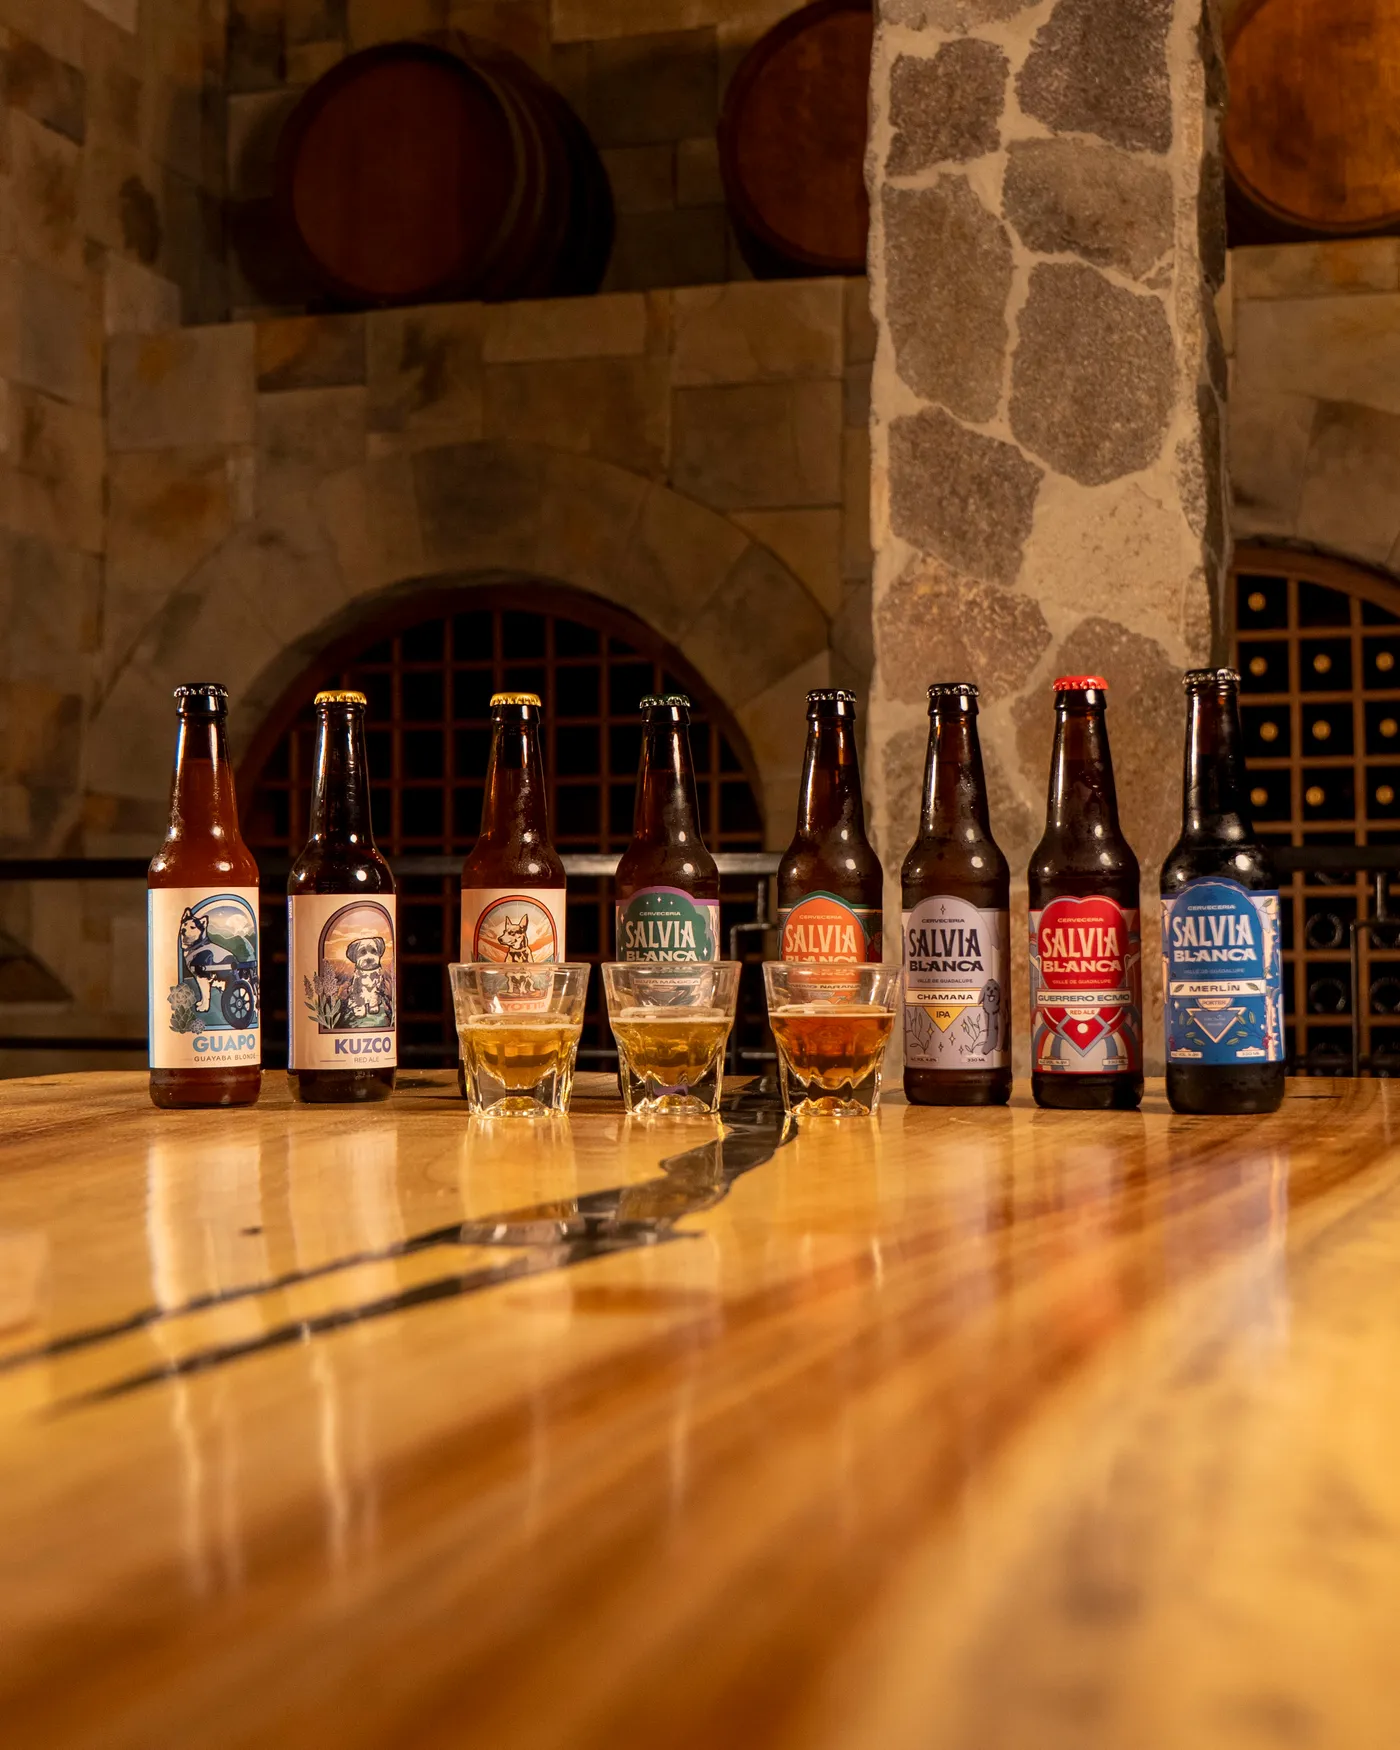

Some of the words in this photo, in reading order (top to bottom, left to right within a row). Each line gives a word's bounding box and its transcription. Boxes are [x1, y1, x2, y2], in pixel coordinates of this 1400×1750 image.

[625, 920, 696, 948] SALVIA
[785, 924, 858, 953] SALVIA
[1172, 914, 1255, 947] SALVIA
[909, 928, 982, 957] SALVIA
[1042, 927, 1120, 958] SALVIA
[626, 950, 699, 962] BLANCA
[1173, 948, 1257, 962] BLANCA
[909, 960, 984, 972] BLANCA
[1043, 959, 1122, 973] BLANCA
[1189, 982, 1241, 992] MERLÍN
[1038, 994, 1095, 1002] GUERRERO
[1097, 993, 1130, 1002] ECMO
[192, 1034, 256, 1053] GUAPO
[334, 1037, 392, 1055] KUZCO
